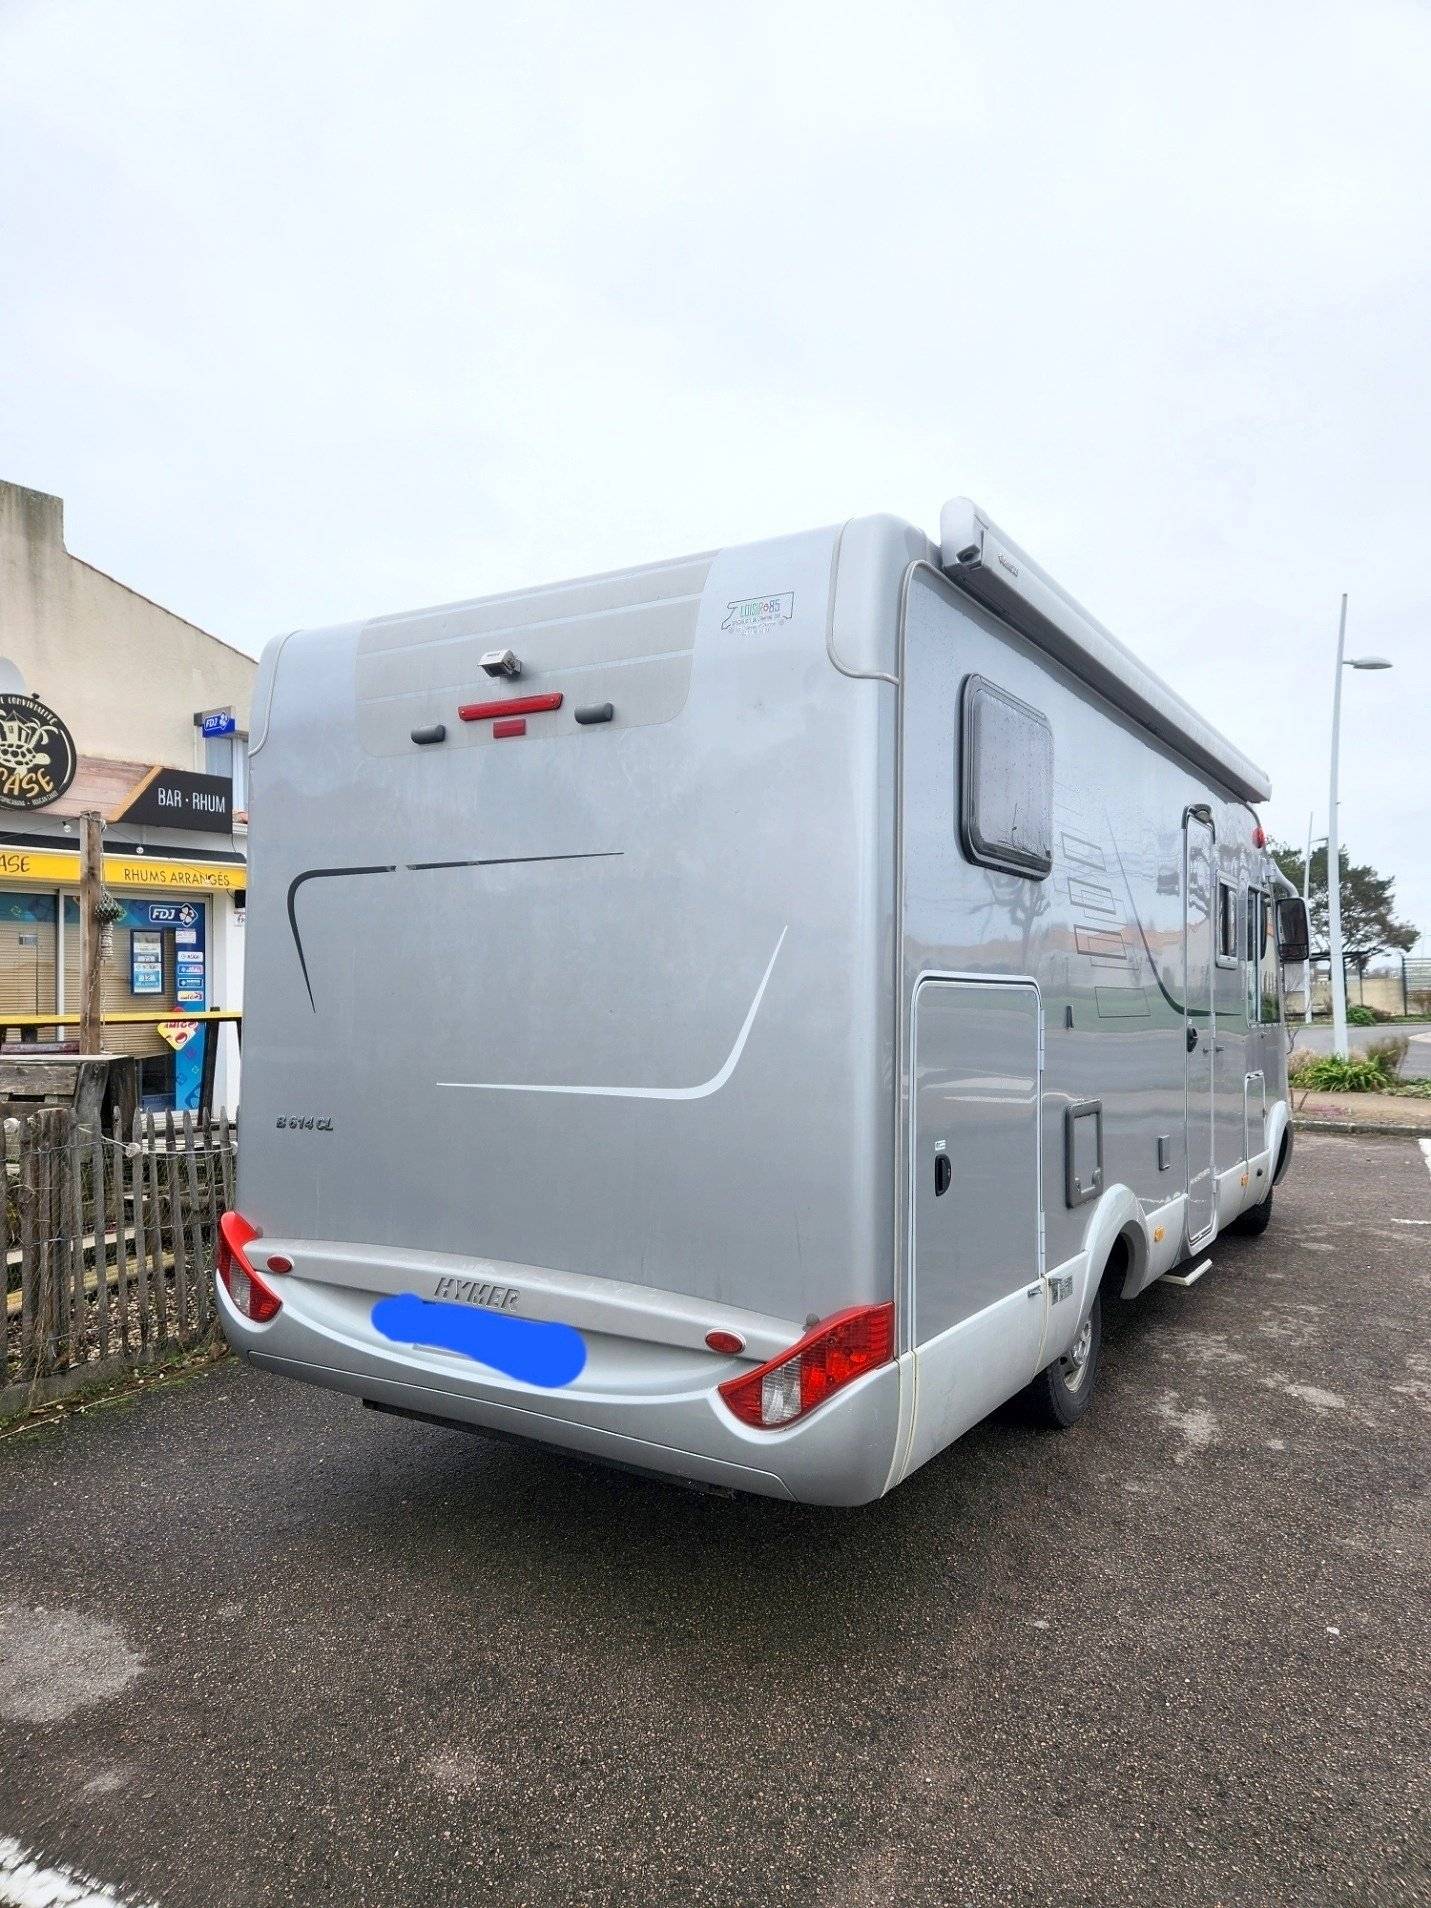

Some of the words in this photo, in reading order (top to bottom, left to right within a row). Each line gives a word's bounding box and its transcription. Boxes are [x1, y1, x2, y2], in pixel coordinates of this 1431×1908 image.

[205, 717, 218, 730] FDJ
[157, 787, 183, 808] BAR
[192, 791, 226, 814] RHUM
[124, 868, 167, 884] RHUMS
[170, 869, 230, 887] ARRANGÉS
[152, 908, 176, 920] FDJ
[288, 1114, 315, 1131] 614
[434, 1276, 521, 1313] HYMER
